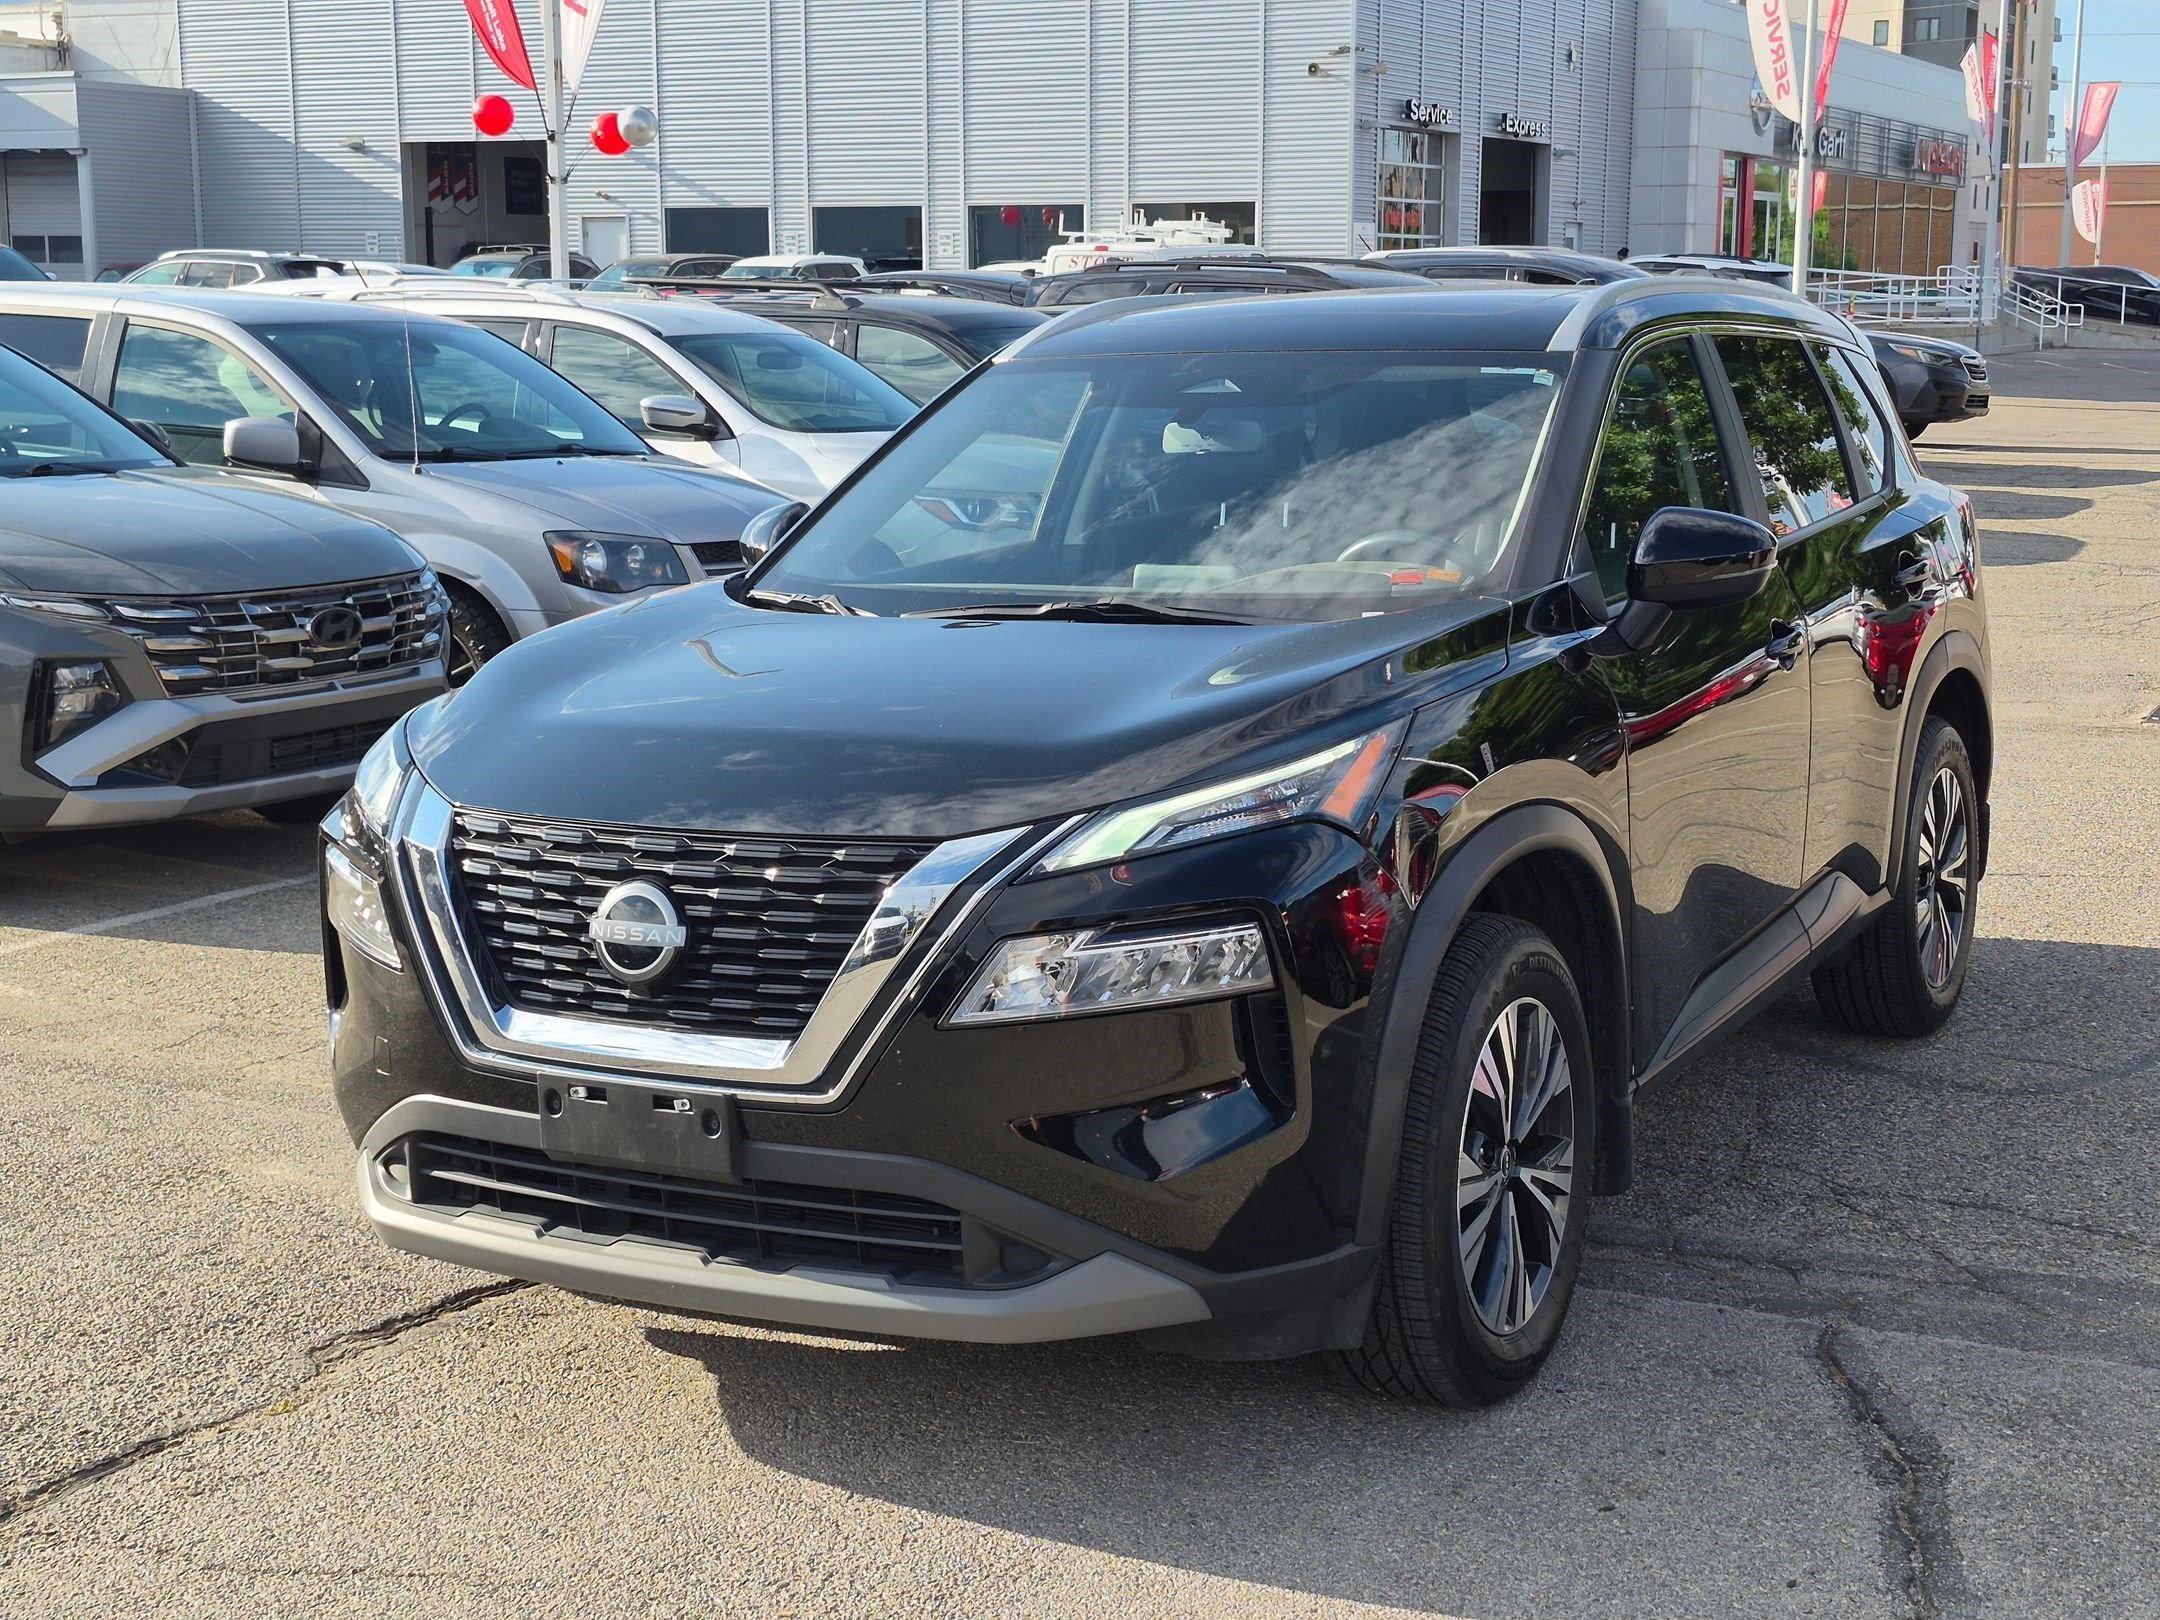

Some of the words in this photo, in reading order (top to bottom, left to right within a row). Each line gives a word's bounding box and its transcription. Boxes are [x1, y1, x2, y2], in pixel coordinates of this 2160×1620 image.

[493, 20, 507, 52] Lake
[1410, 98, 1453, 124] Service
[1506, 113, 1548, 138] Express
[591, 922, 682, 944] NISSAN
